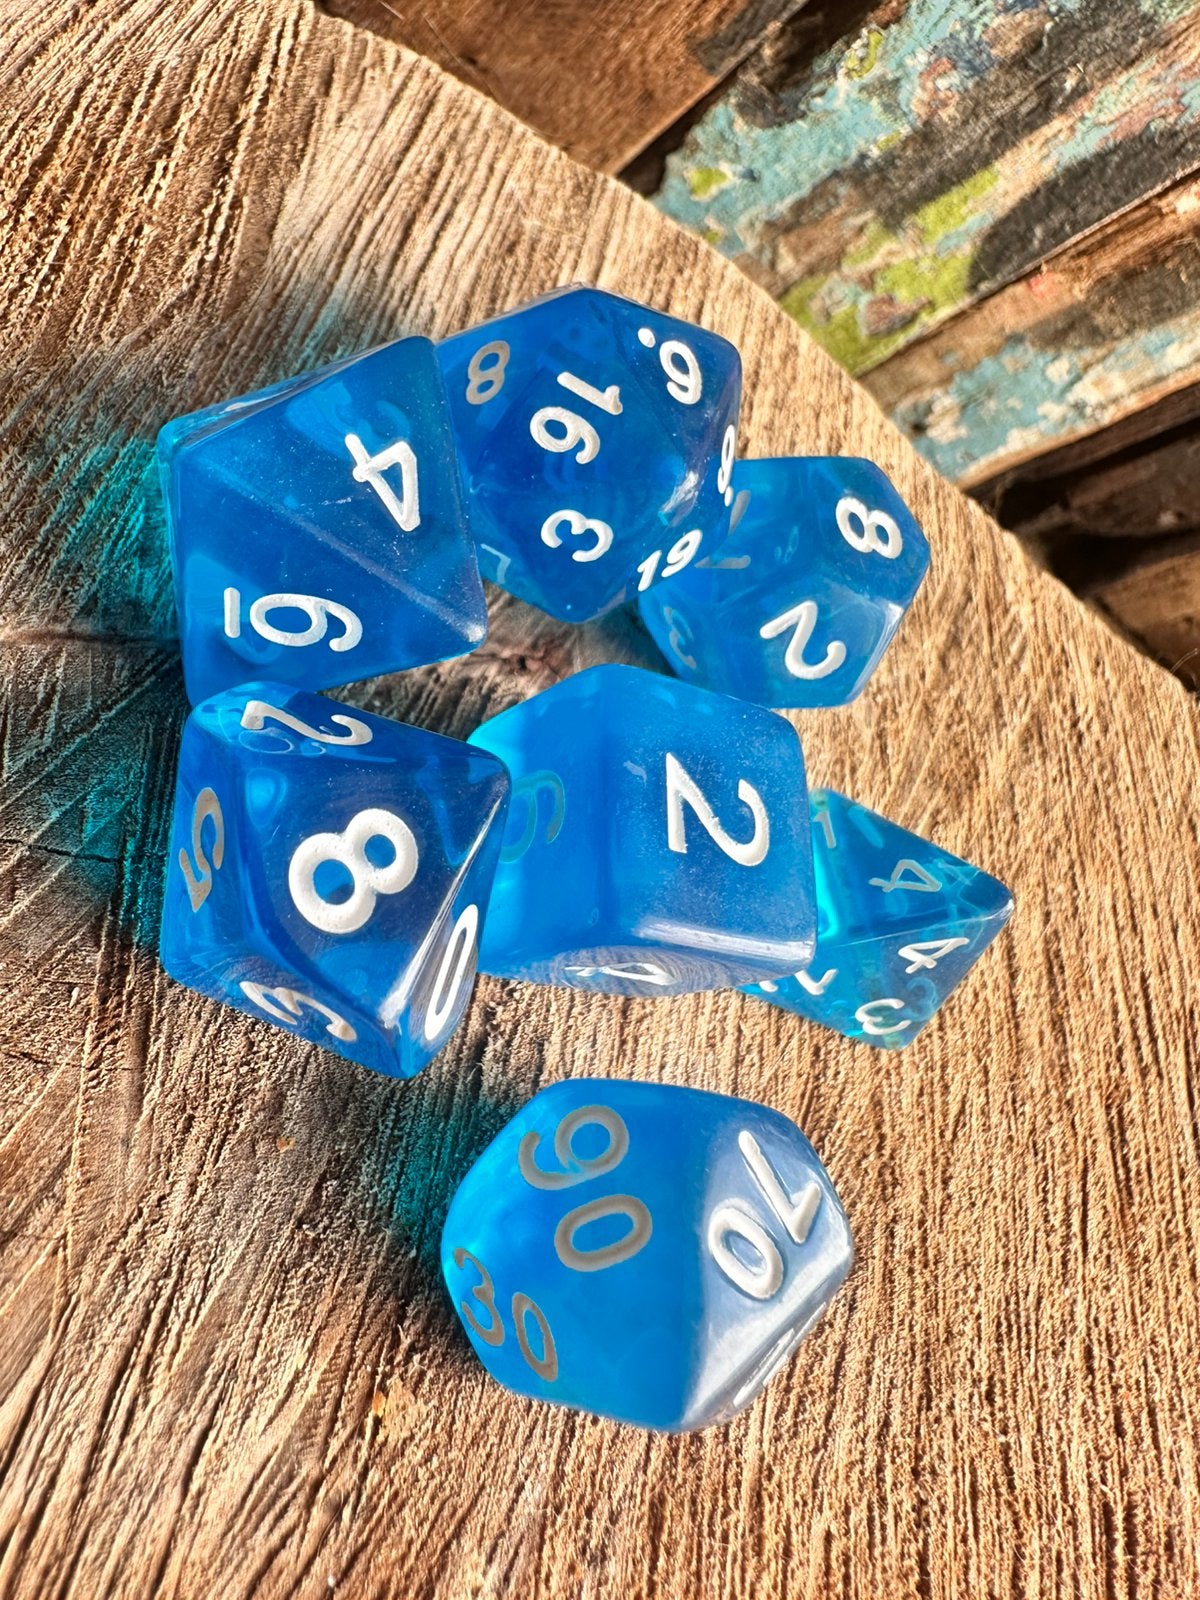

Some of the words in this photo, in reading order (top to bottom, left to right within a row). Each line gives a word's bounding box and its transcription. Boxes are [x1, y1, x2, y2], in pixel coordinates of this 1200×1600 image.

[466, 340, 510, 405] 8
[530, 371, 624, 465] 16
[345, 433, 420, 532] 4
[541, 509, 614, 563] 3
[637, 529, 702, 592] 19
[836, 495, 903, 560] 8
[759, 600, 847, 680] 2
[240, 700, 373, 746] 2
[665, 752, 771, 867] 2
[179, 786, 225, 914] 5
[288, 807, 420, 935] 8
[868, 859, 943, 893] 4
[424, 903, 478, 1041] 0
[898, 937, 970, 974] 4
[239, 980, 358, 1042] 3
[854, 997, 912, 1036] 3
[518, 1105, 653, 1272] 90
[454, 1247, 559, 1383] 30
